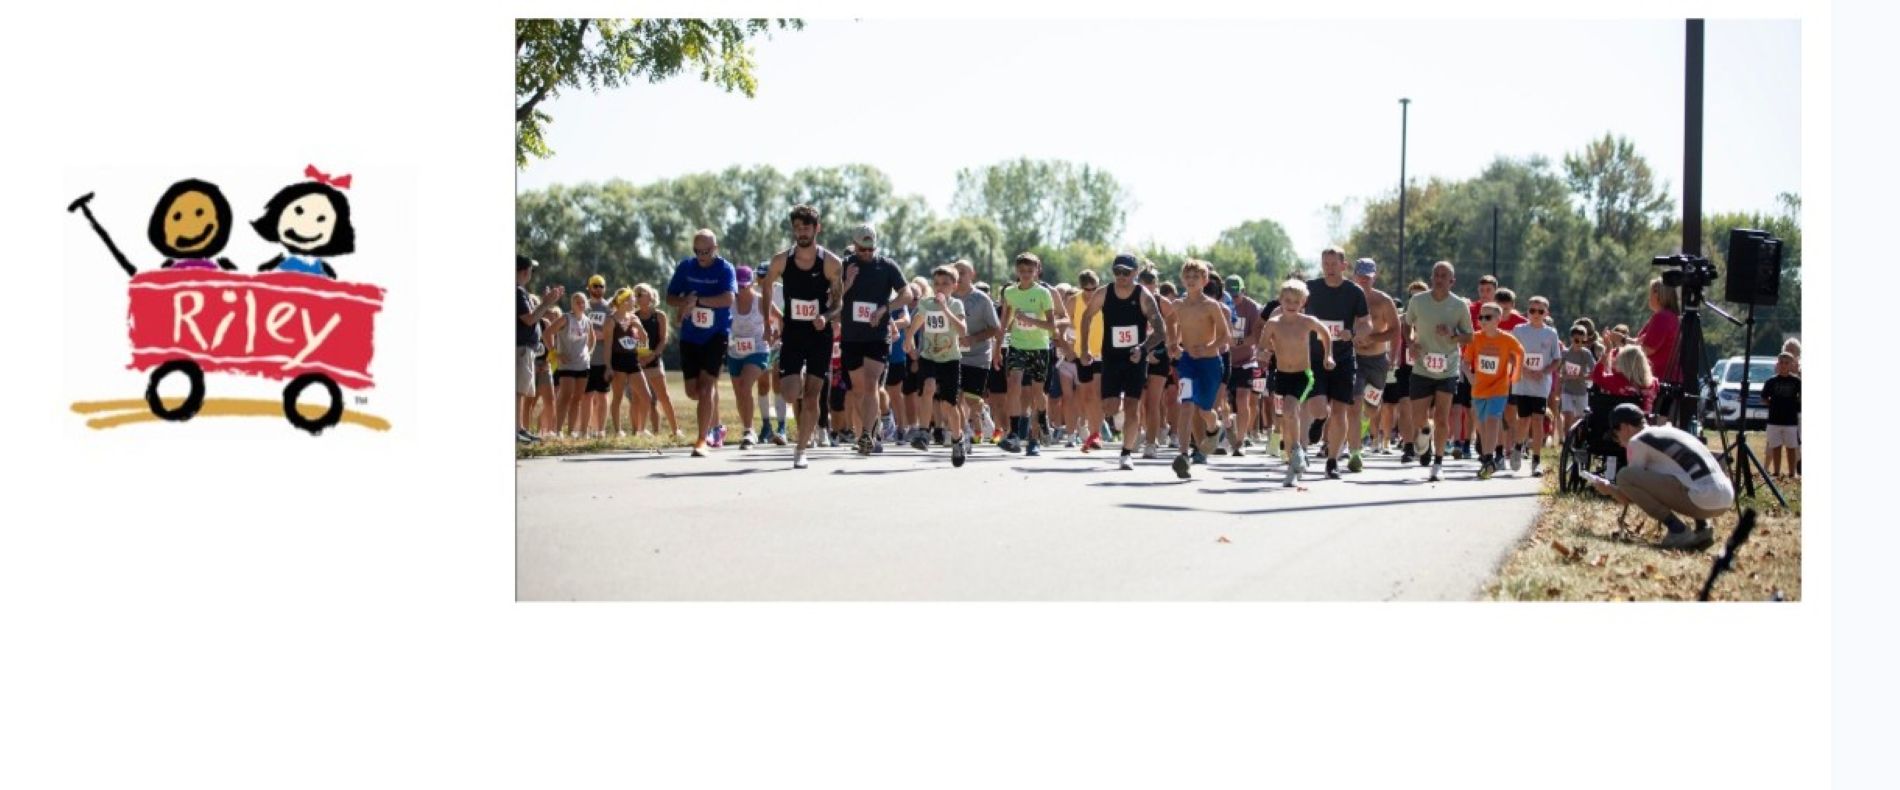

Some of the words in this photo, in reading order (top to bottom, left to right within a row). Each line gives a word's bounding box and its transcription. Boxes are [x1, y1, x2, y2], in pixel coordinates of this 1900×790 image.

[795, 304, 816, 317] 102
[927, 315, 945, 329] 499
[173, 290, 341, 370] Riley
[1118, 330, 1131, 343] 35
[1481, 359, 1495, 370] 500
